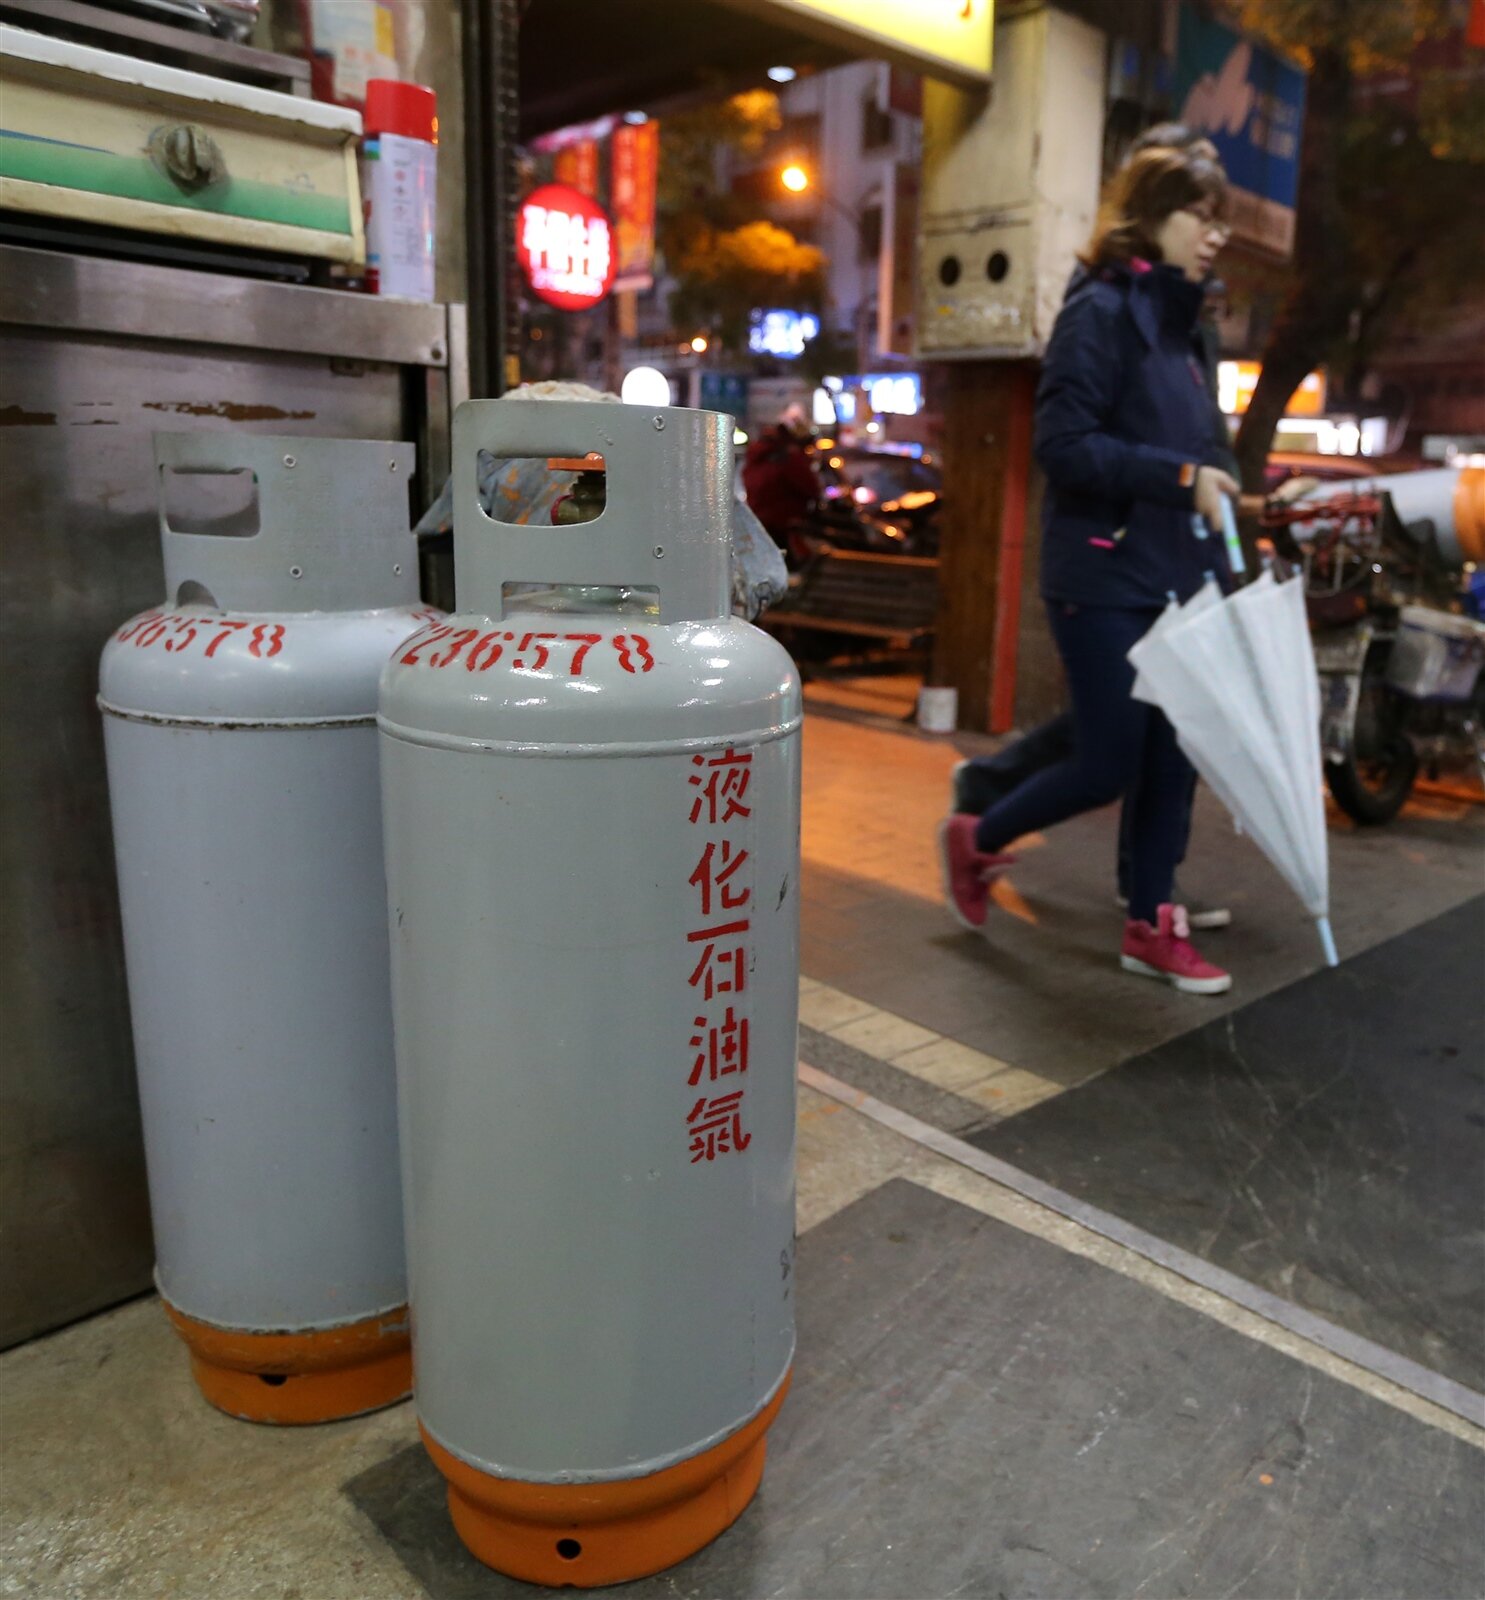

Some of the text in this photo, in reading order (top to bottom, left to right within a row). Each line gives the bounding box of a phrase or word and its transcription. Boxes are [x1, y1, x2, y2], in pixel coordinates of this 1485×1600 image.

[113, 608, 286, 658] 36578
[686, 747, 753, 1164] 液化石油氣
